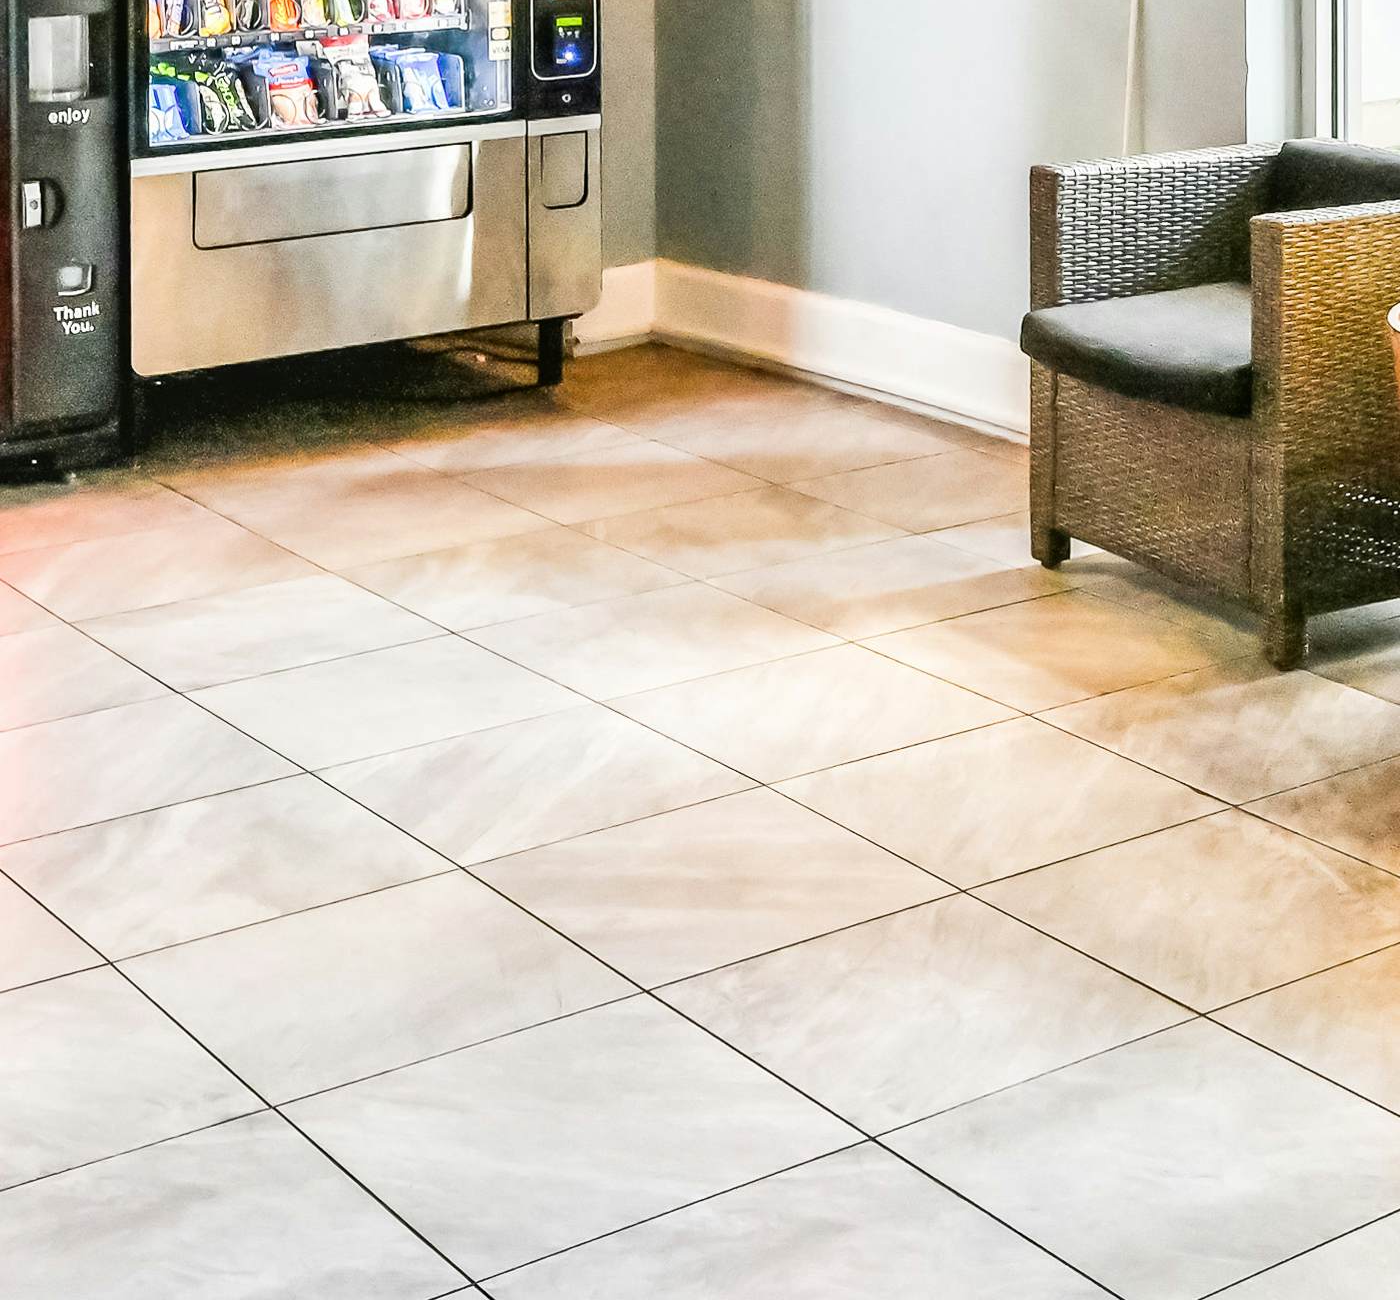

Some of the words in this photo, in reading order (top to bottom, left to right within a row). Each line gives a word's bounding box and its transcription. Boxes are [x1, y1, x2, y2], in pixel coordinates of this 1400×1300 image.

[48, 107, 90, 125] enjoy
[52, 300, 100, 322] Thank
[61, 320, 95, 335] You.
